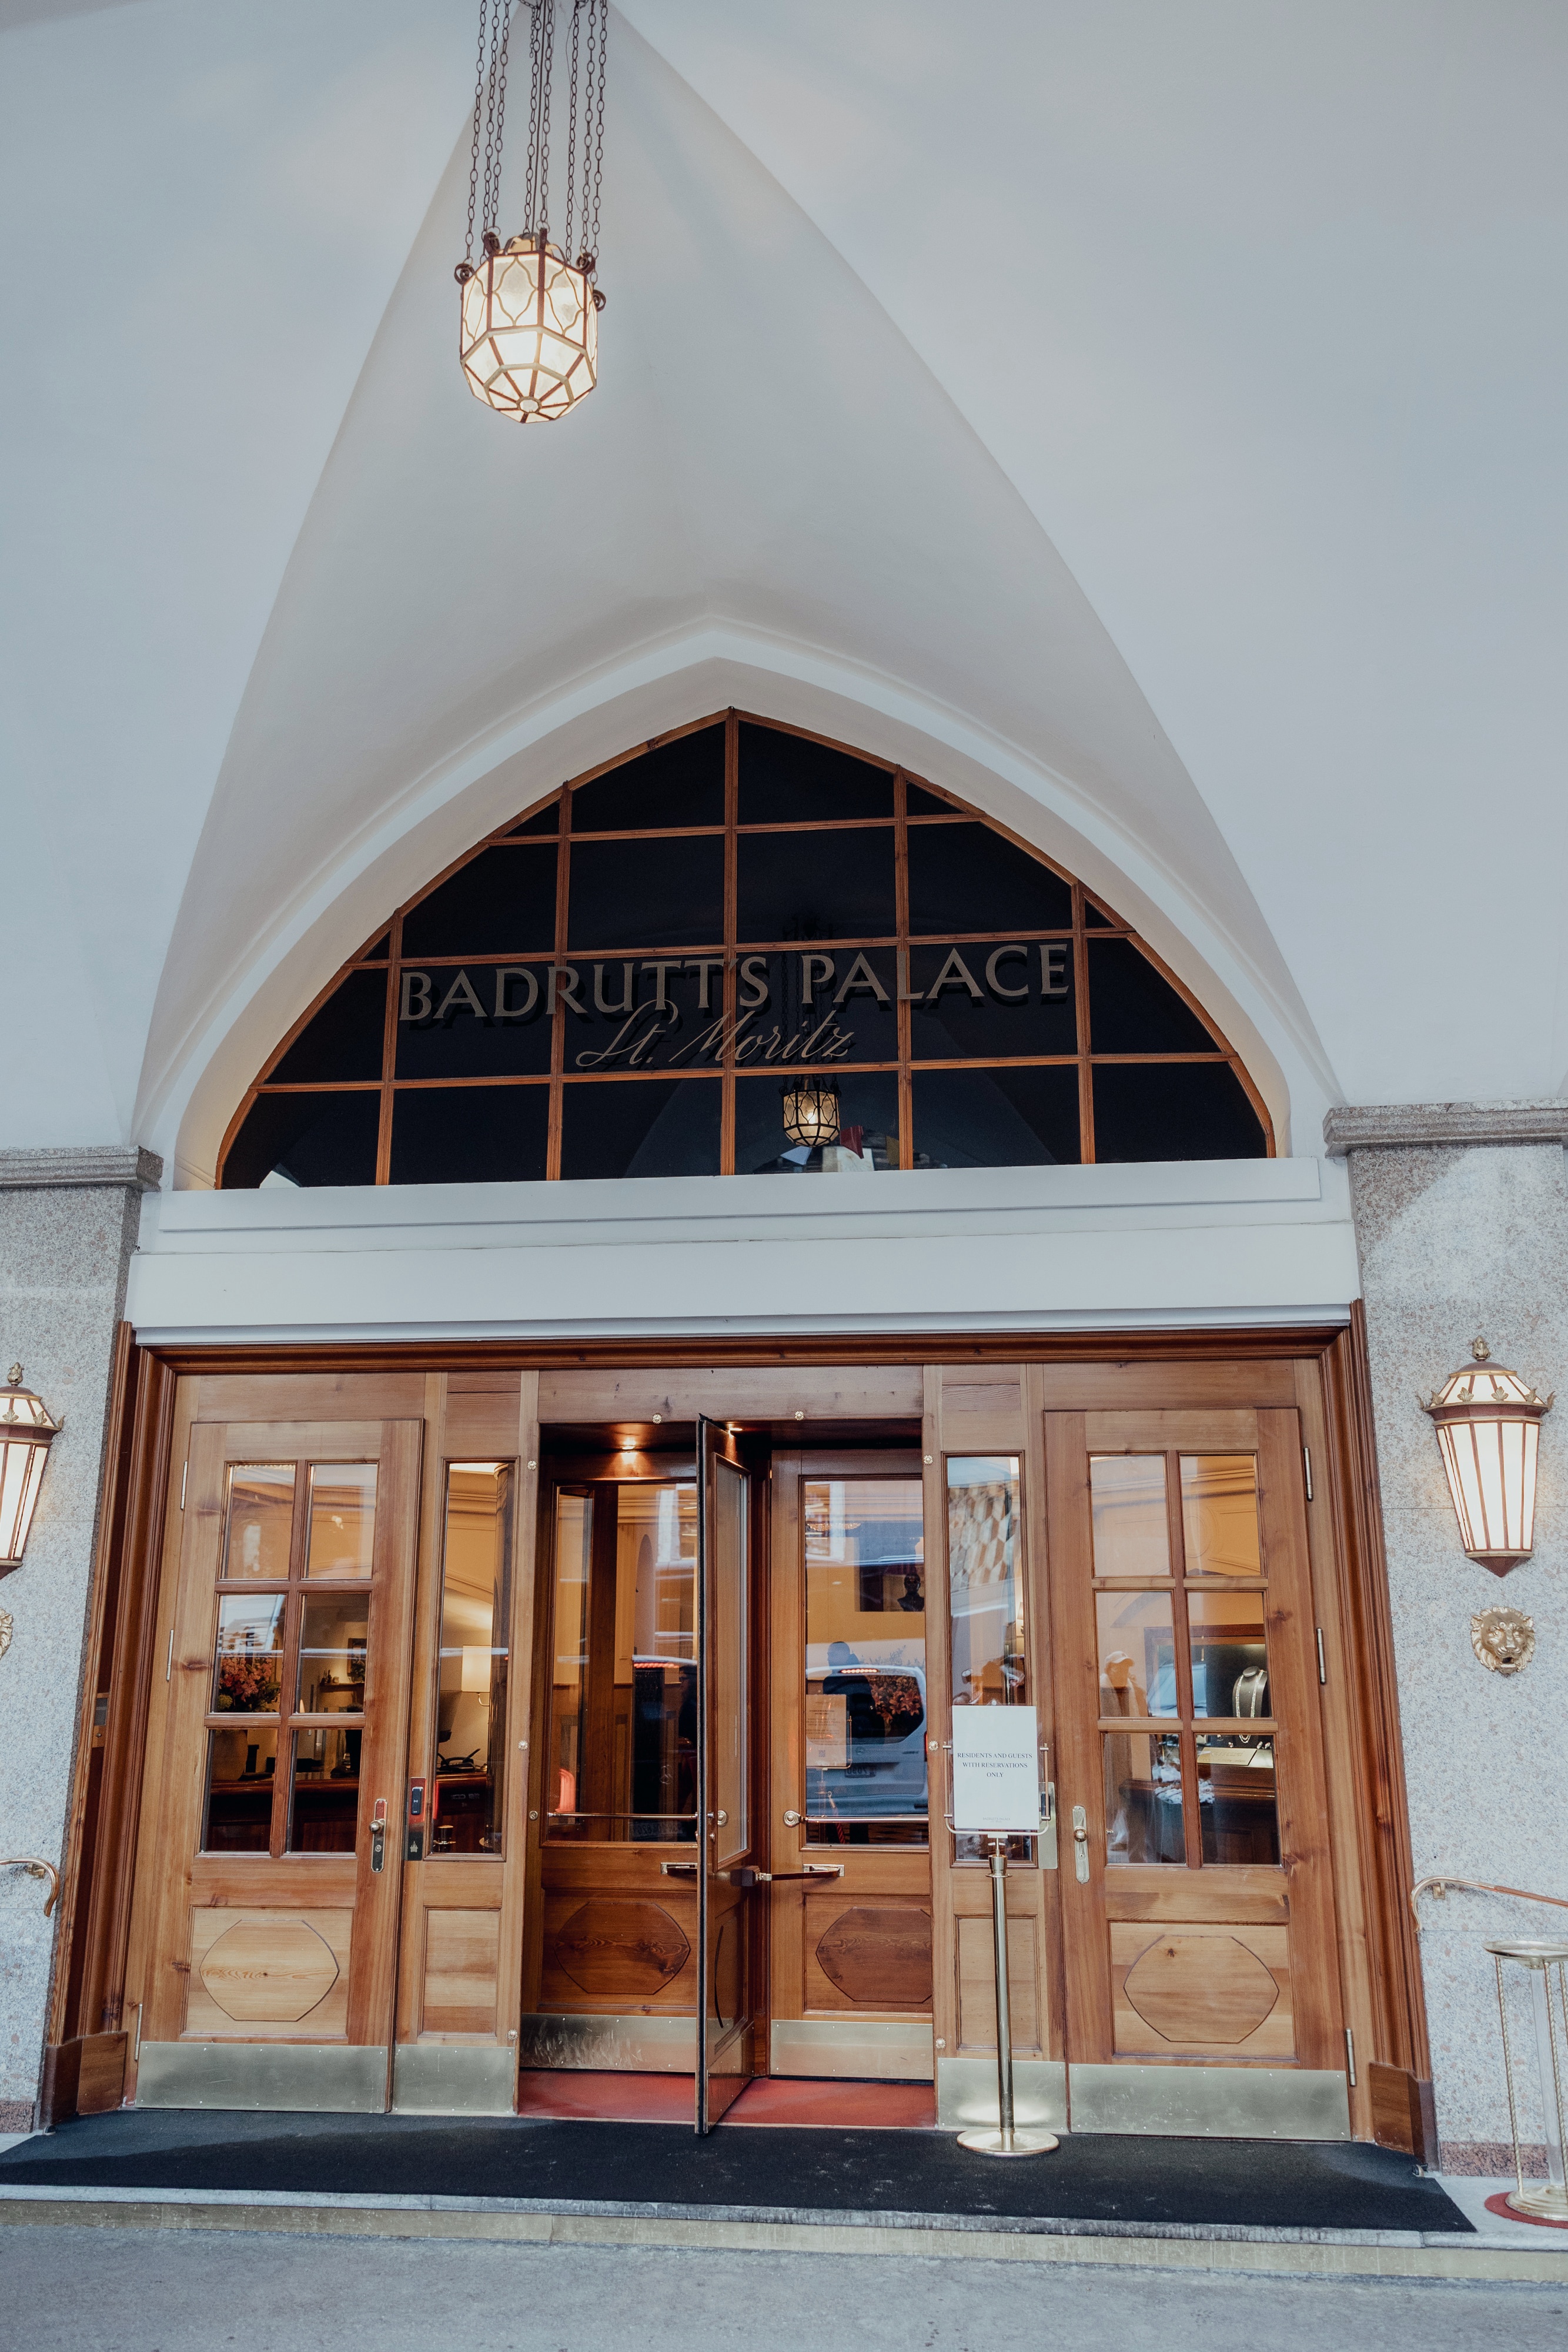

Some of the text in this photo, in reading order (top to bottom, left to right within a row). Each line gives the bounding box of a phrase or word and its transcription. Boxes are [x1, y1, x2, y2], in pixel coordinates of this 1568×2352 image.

[399, 943, 1069, 1021] BADRUTT'S PALACE
[575, 998, 854, 1067] St. Moritz
